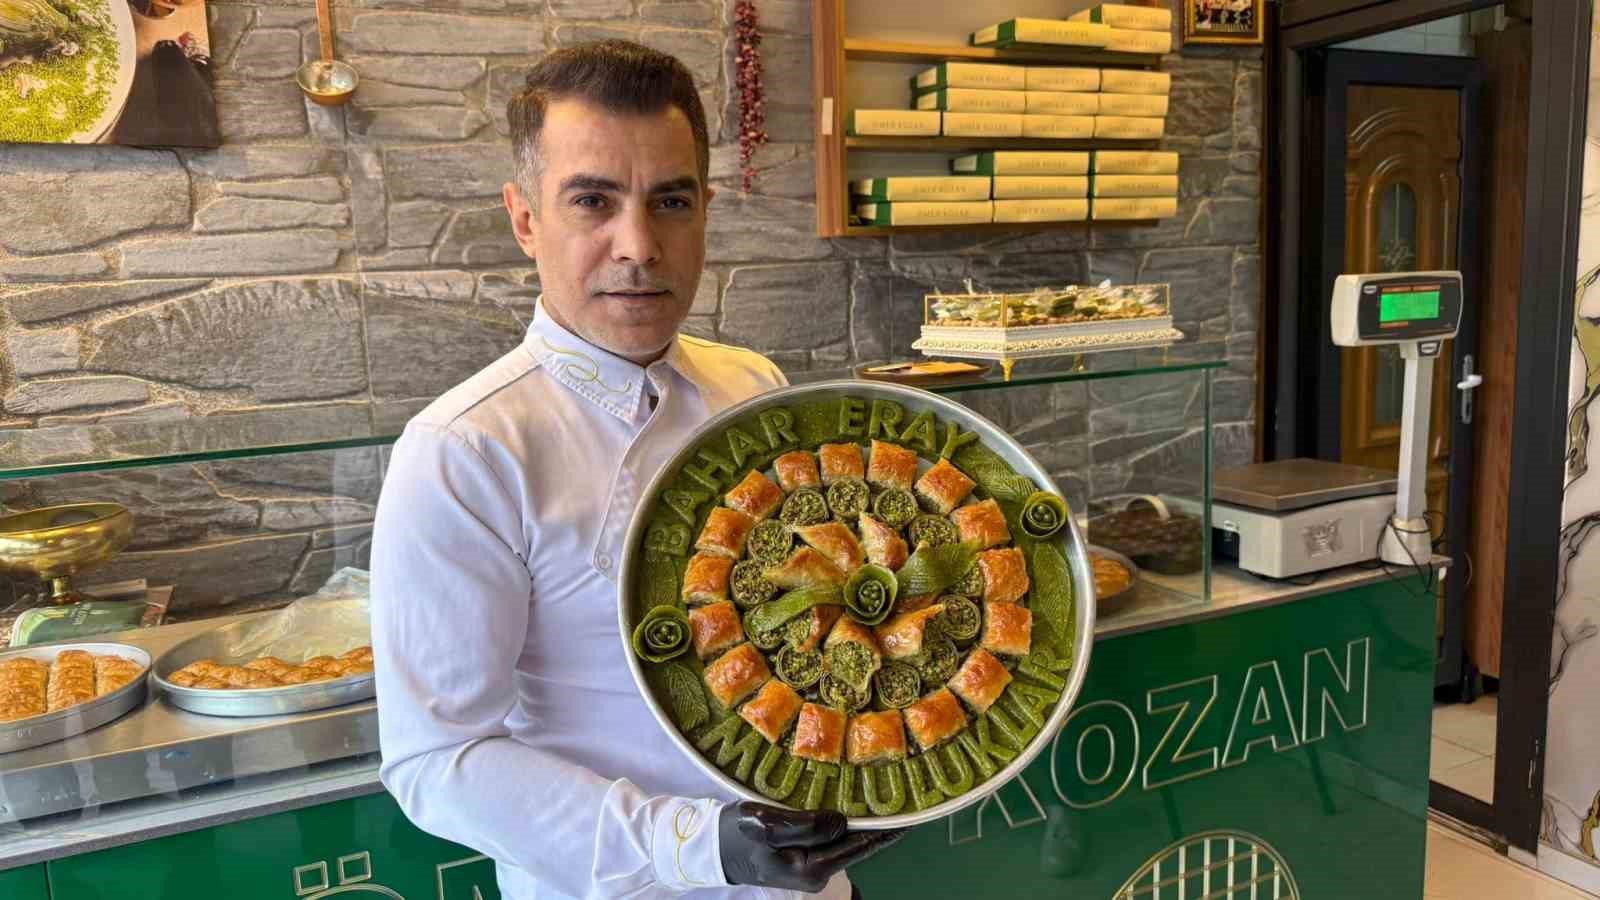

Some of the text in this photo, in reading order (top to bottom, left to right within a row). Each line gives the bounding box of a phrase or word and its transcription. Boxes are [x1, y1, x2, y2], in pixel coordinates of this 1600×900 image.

[644, 396, 980, 555] BAHAR ERAY
[700, 647, 1076, 817] MUTLULUKLAR
